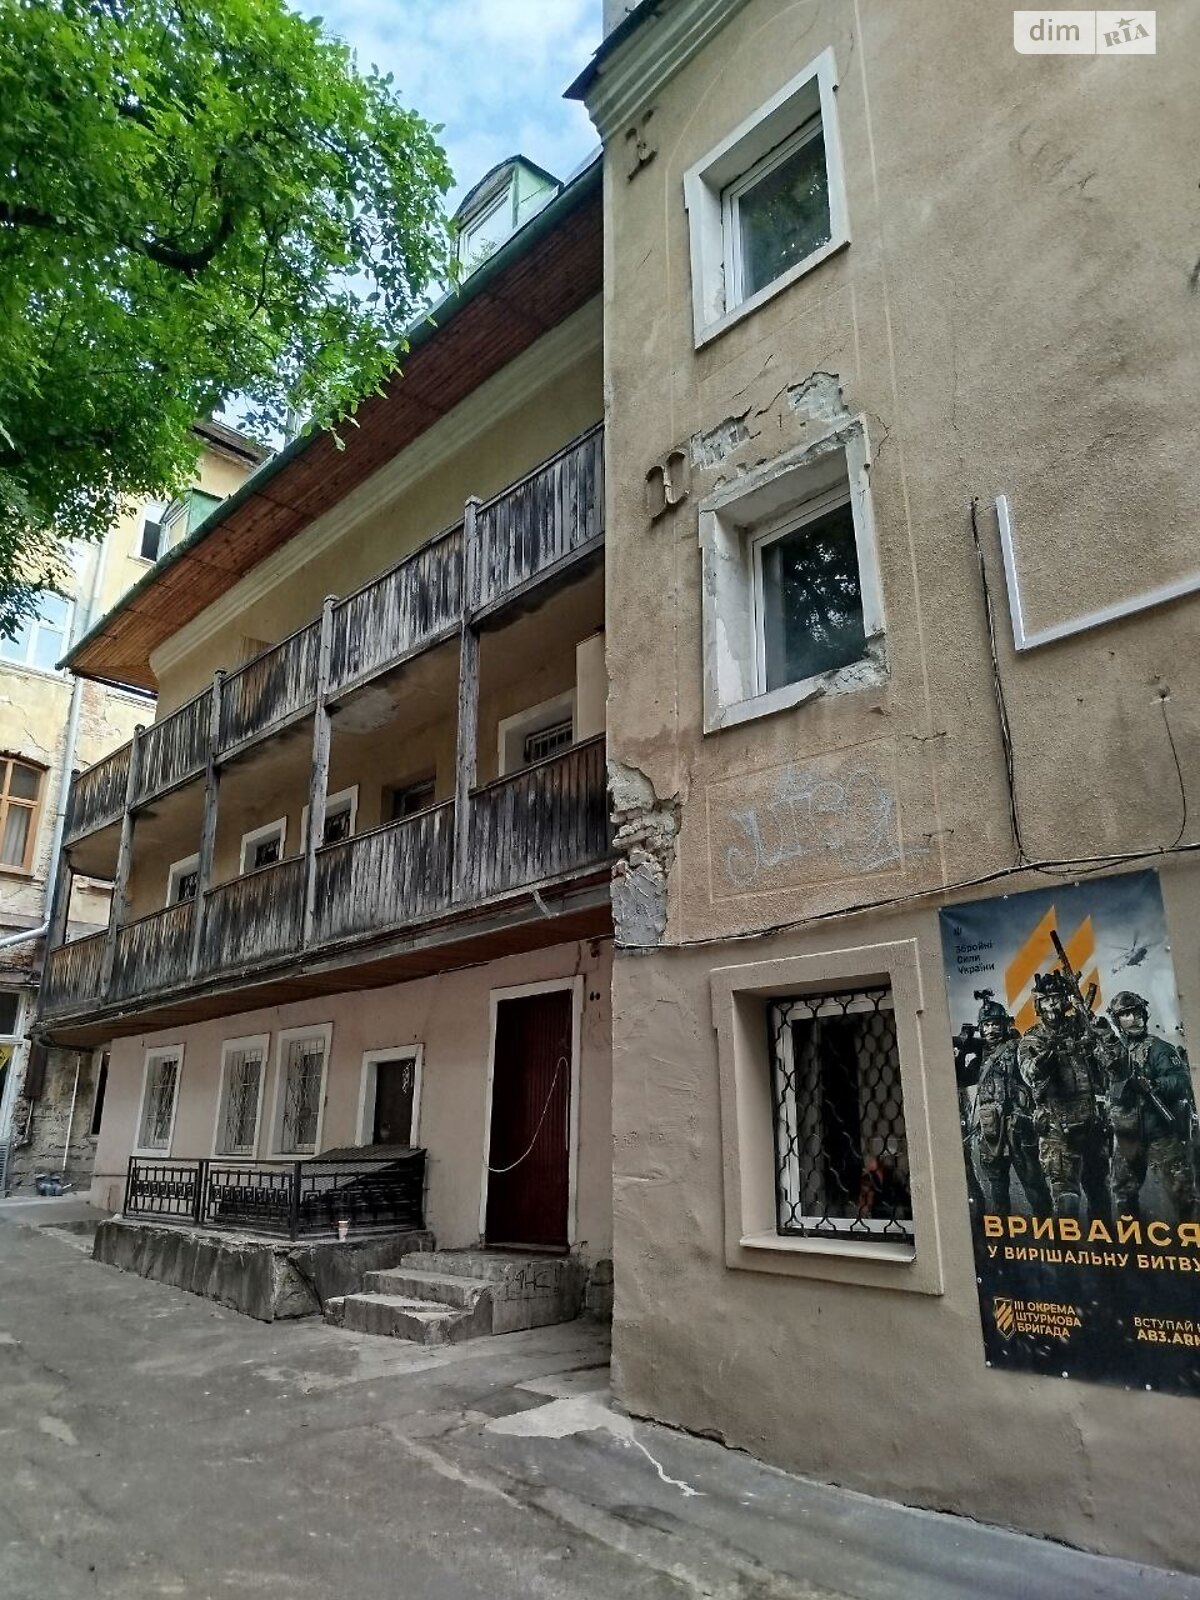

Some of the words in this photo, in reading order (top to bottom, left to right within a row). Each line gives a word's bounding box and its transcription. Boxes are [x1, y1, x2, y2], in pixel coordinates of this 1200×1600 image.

[957, 954, 981, 964] Сили
[957, 963, 995, 975] України
[983, 1214, 1200, 1249] ВРИВАЙСЯ
[987, 1245, 998, 1258] У
[1004, 1246, 1129, 1268] ВИРІШАЛЬНУ
[1027, 1301, 1076, 1316] ОКРЕМА
[1015, 1311, 1082, 1328] ШТУРМОВА
[1134, 1316, 1194, 1332] ВСТУПАЙ
[1017, 1322, 1071, 1338] БРИГАДА
